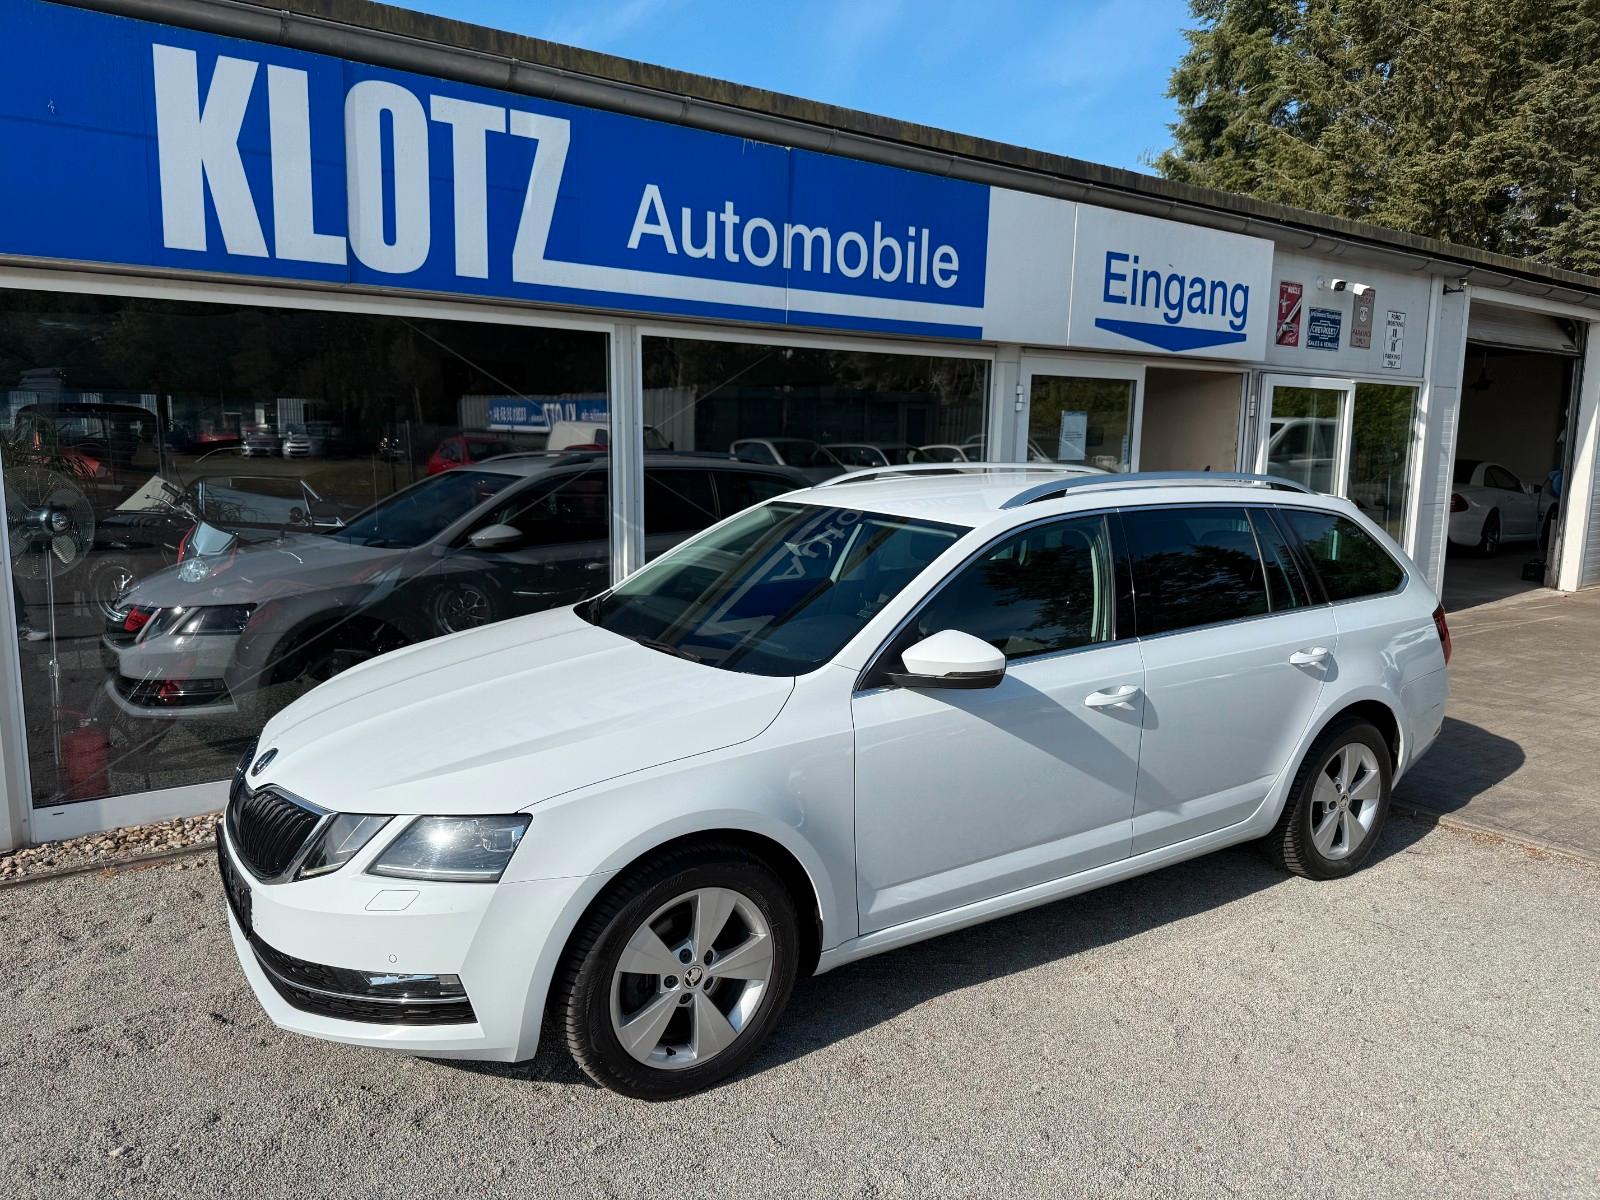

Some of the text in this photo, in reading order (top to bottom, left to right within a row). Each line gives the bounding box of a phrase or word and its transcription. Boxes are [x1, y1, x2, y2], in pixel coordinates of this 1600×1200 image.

[152, 43, 960, 289] KLOTZ Automobile
[1103, 251, 1250, 332] Eingang
